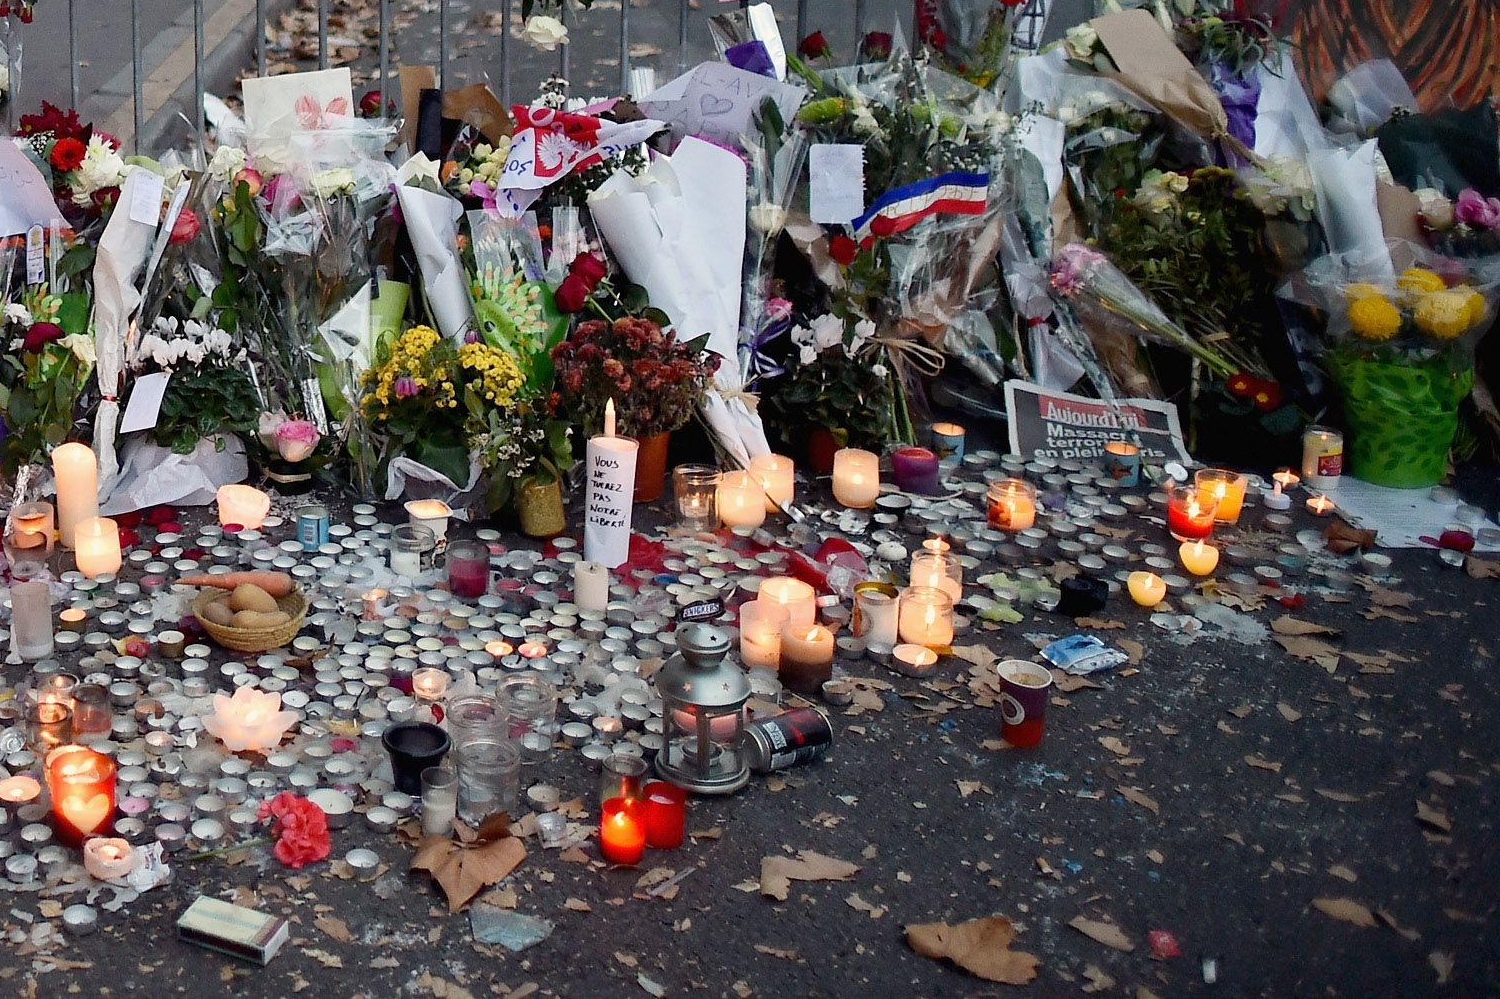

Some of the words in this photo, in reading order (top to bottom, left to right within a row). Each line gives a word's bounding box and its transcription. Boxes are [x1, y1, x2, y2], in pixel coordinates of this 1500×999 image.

[1034, 449, 1058, 458] en
[595, 456, 619, 468] VOUS
[593, 470, 606, 478] NE
[591, 480, 622, 492] TUEREZ
[593, 493, 611, 502] PAS
[590, 504, 621, 515] NOTRE
[684, 603, 720, 617] SNICKERS
